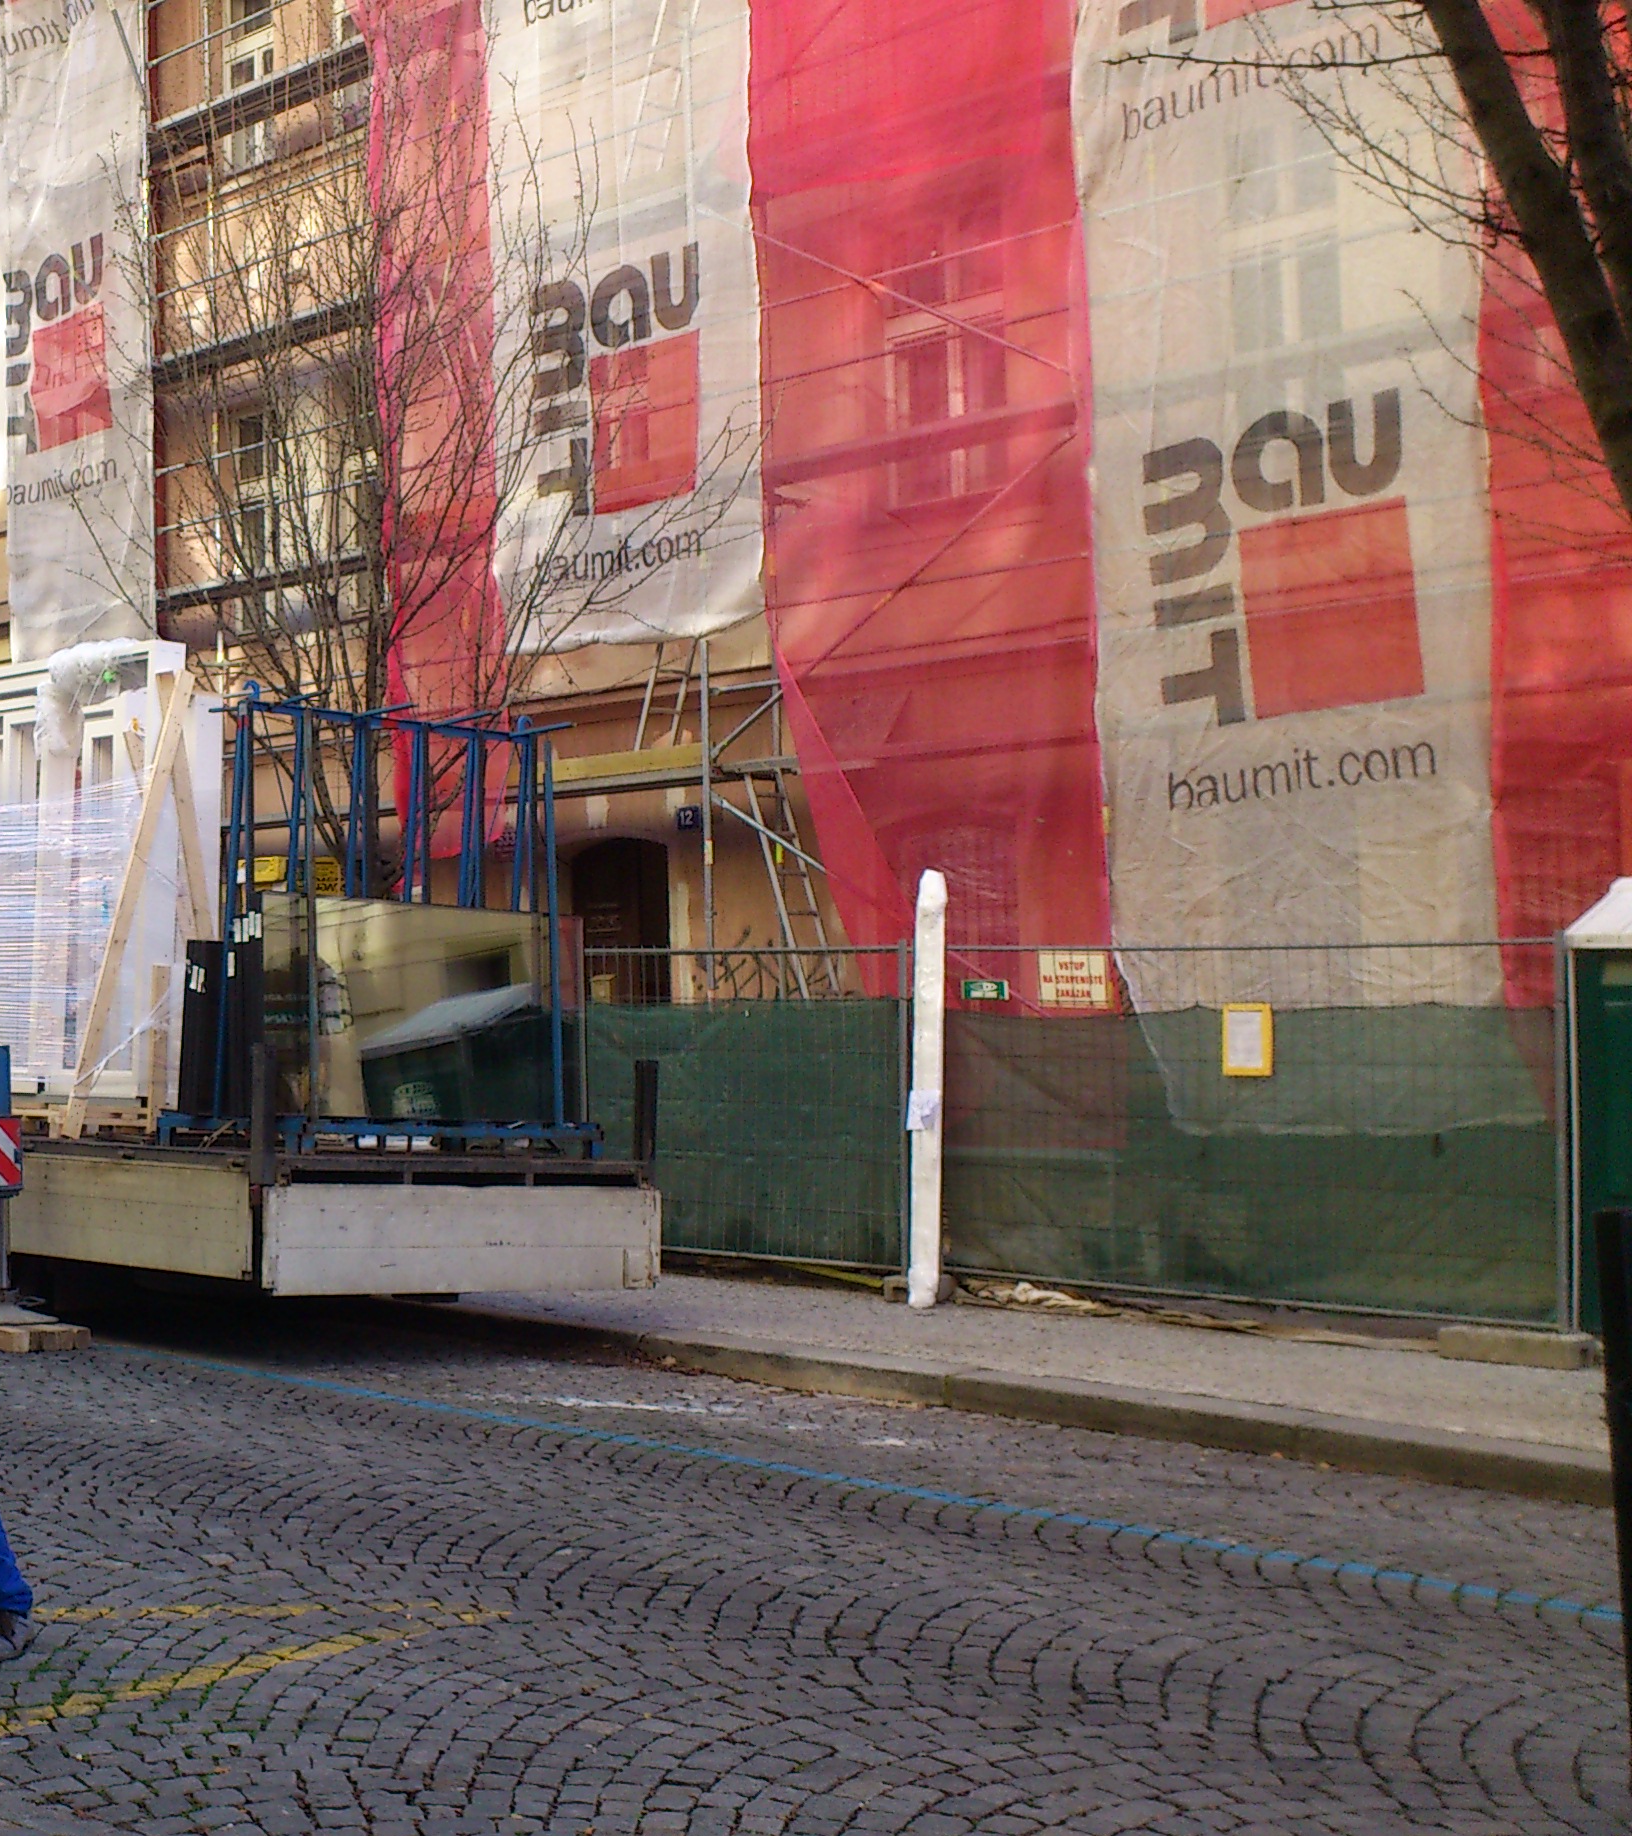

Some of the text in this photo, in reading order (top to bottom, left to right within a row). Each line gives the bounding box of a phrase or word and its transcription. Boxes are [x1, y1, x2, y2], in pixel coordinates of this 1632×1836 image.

[1122, 23, 1381, 142] baumit.com
[1168, 740, 1437, 811] baumit.com
[680, 810, 693, 825] 12
[1058, 961, 1085, 971] VSTUP
